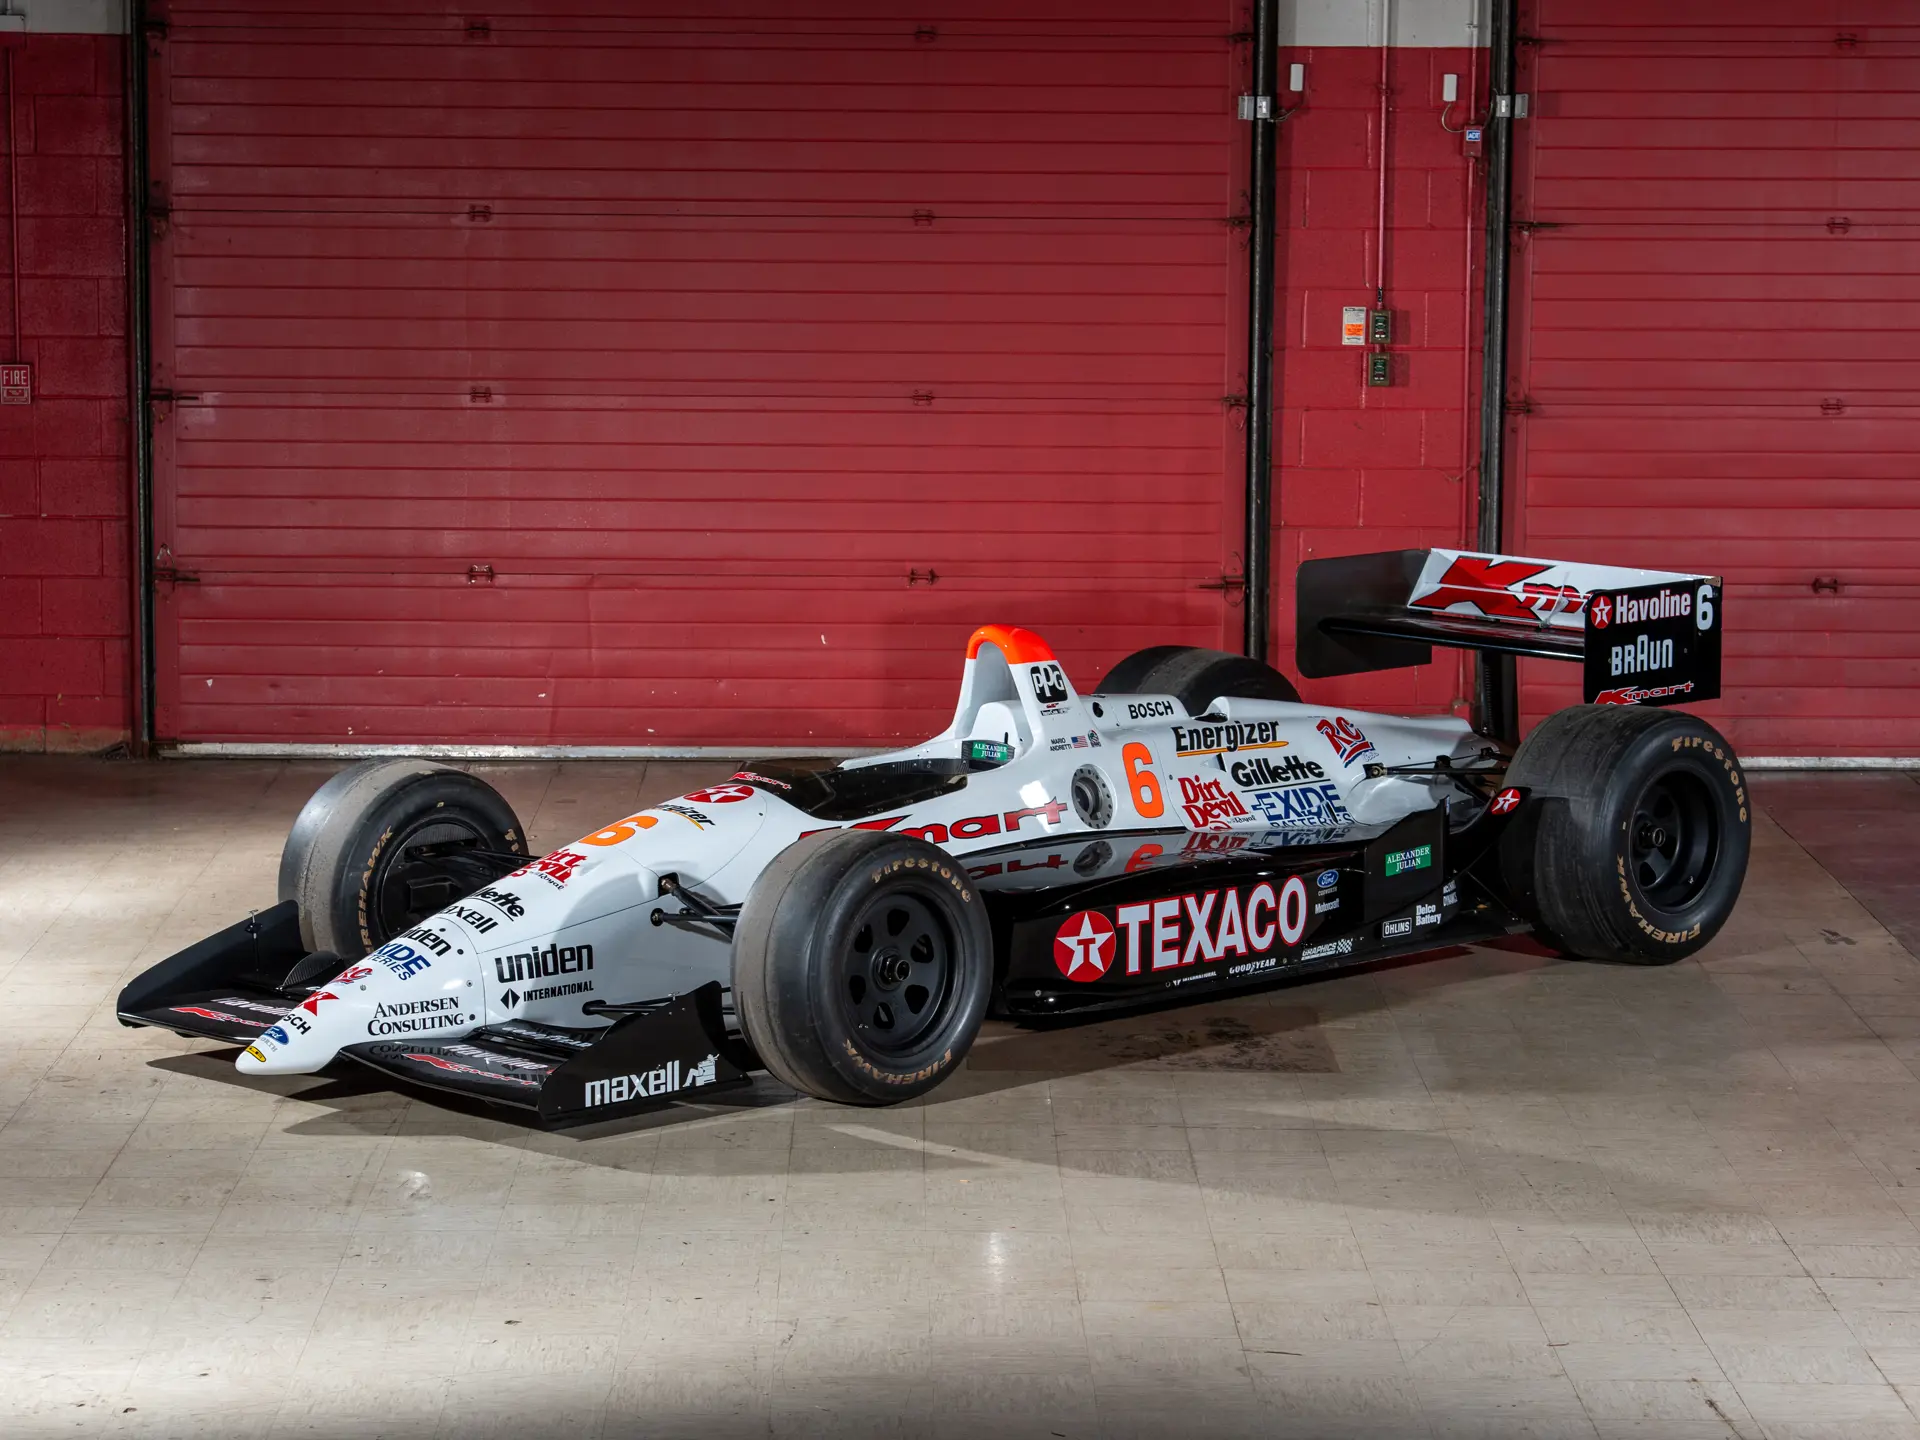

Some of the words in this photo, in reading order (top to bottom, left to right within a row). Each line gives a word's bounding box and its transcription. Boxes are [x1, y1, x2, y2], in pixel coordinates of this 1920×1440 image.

[3, 370, 27, 385] FIRE
[1615, 589, 1692, 624] Havoline
[1696, 584, 1714, 631] 6
[1032, 665, 1065, 697] PPG
[1594, 681, 1694, 705] Kmart
[1128, 700, 1174, 719] BOSCH
[974, 743, 1007, 752] ALEXANDER
[1050, 743, 1072, 751] ANDRETTI
[1051, 737, 1066, 745] MARIO
[1171, 720, 1279, 752] Energizer
[1316, 716, 1366, 760] RC
[981, 750, 1001, 758] JULIAN
[1122, 742, 1165, 818] 6
[1231, 755, 1325, 788] Gillette
[1671, 736, 1747, 823] Firestone
[1178, 775, 1229, 804] Dirt
[1251, 784, 1347, 821] EXIDE
[1182, 791, 1248, 829] Devil
[578, 815, 659, 847] 6
[1387, 847, 1430, 864] ALEXANDER
[1396, 858, 1421, 872] JULIAN
[871, 856, 973, 903] Firestone
[1416, 903, 1437, 916] Delco
[1617, 853, 1701, 944] FIREHAWK
[1116, 876, 1308, 975] TEXACO
[1384, 921, 1410, 935] ÖHLINS
[1415, 913, 1442, 926] Battery
[495, 943, 594, 984] uniden
[1302, 942, 1337, 957] GRAPHICS
[523, 980, 594, 1002] INTERNATIONAL
[374, 996, 459, 1019] ANDERSEN
[367, 1012, 464, 1036] CONSULTING
[843, 1038, 954, 1085] FIREHAWK
[585, 1060, 680, 1107] maxell
